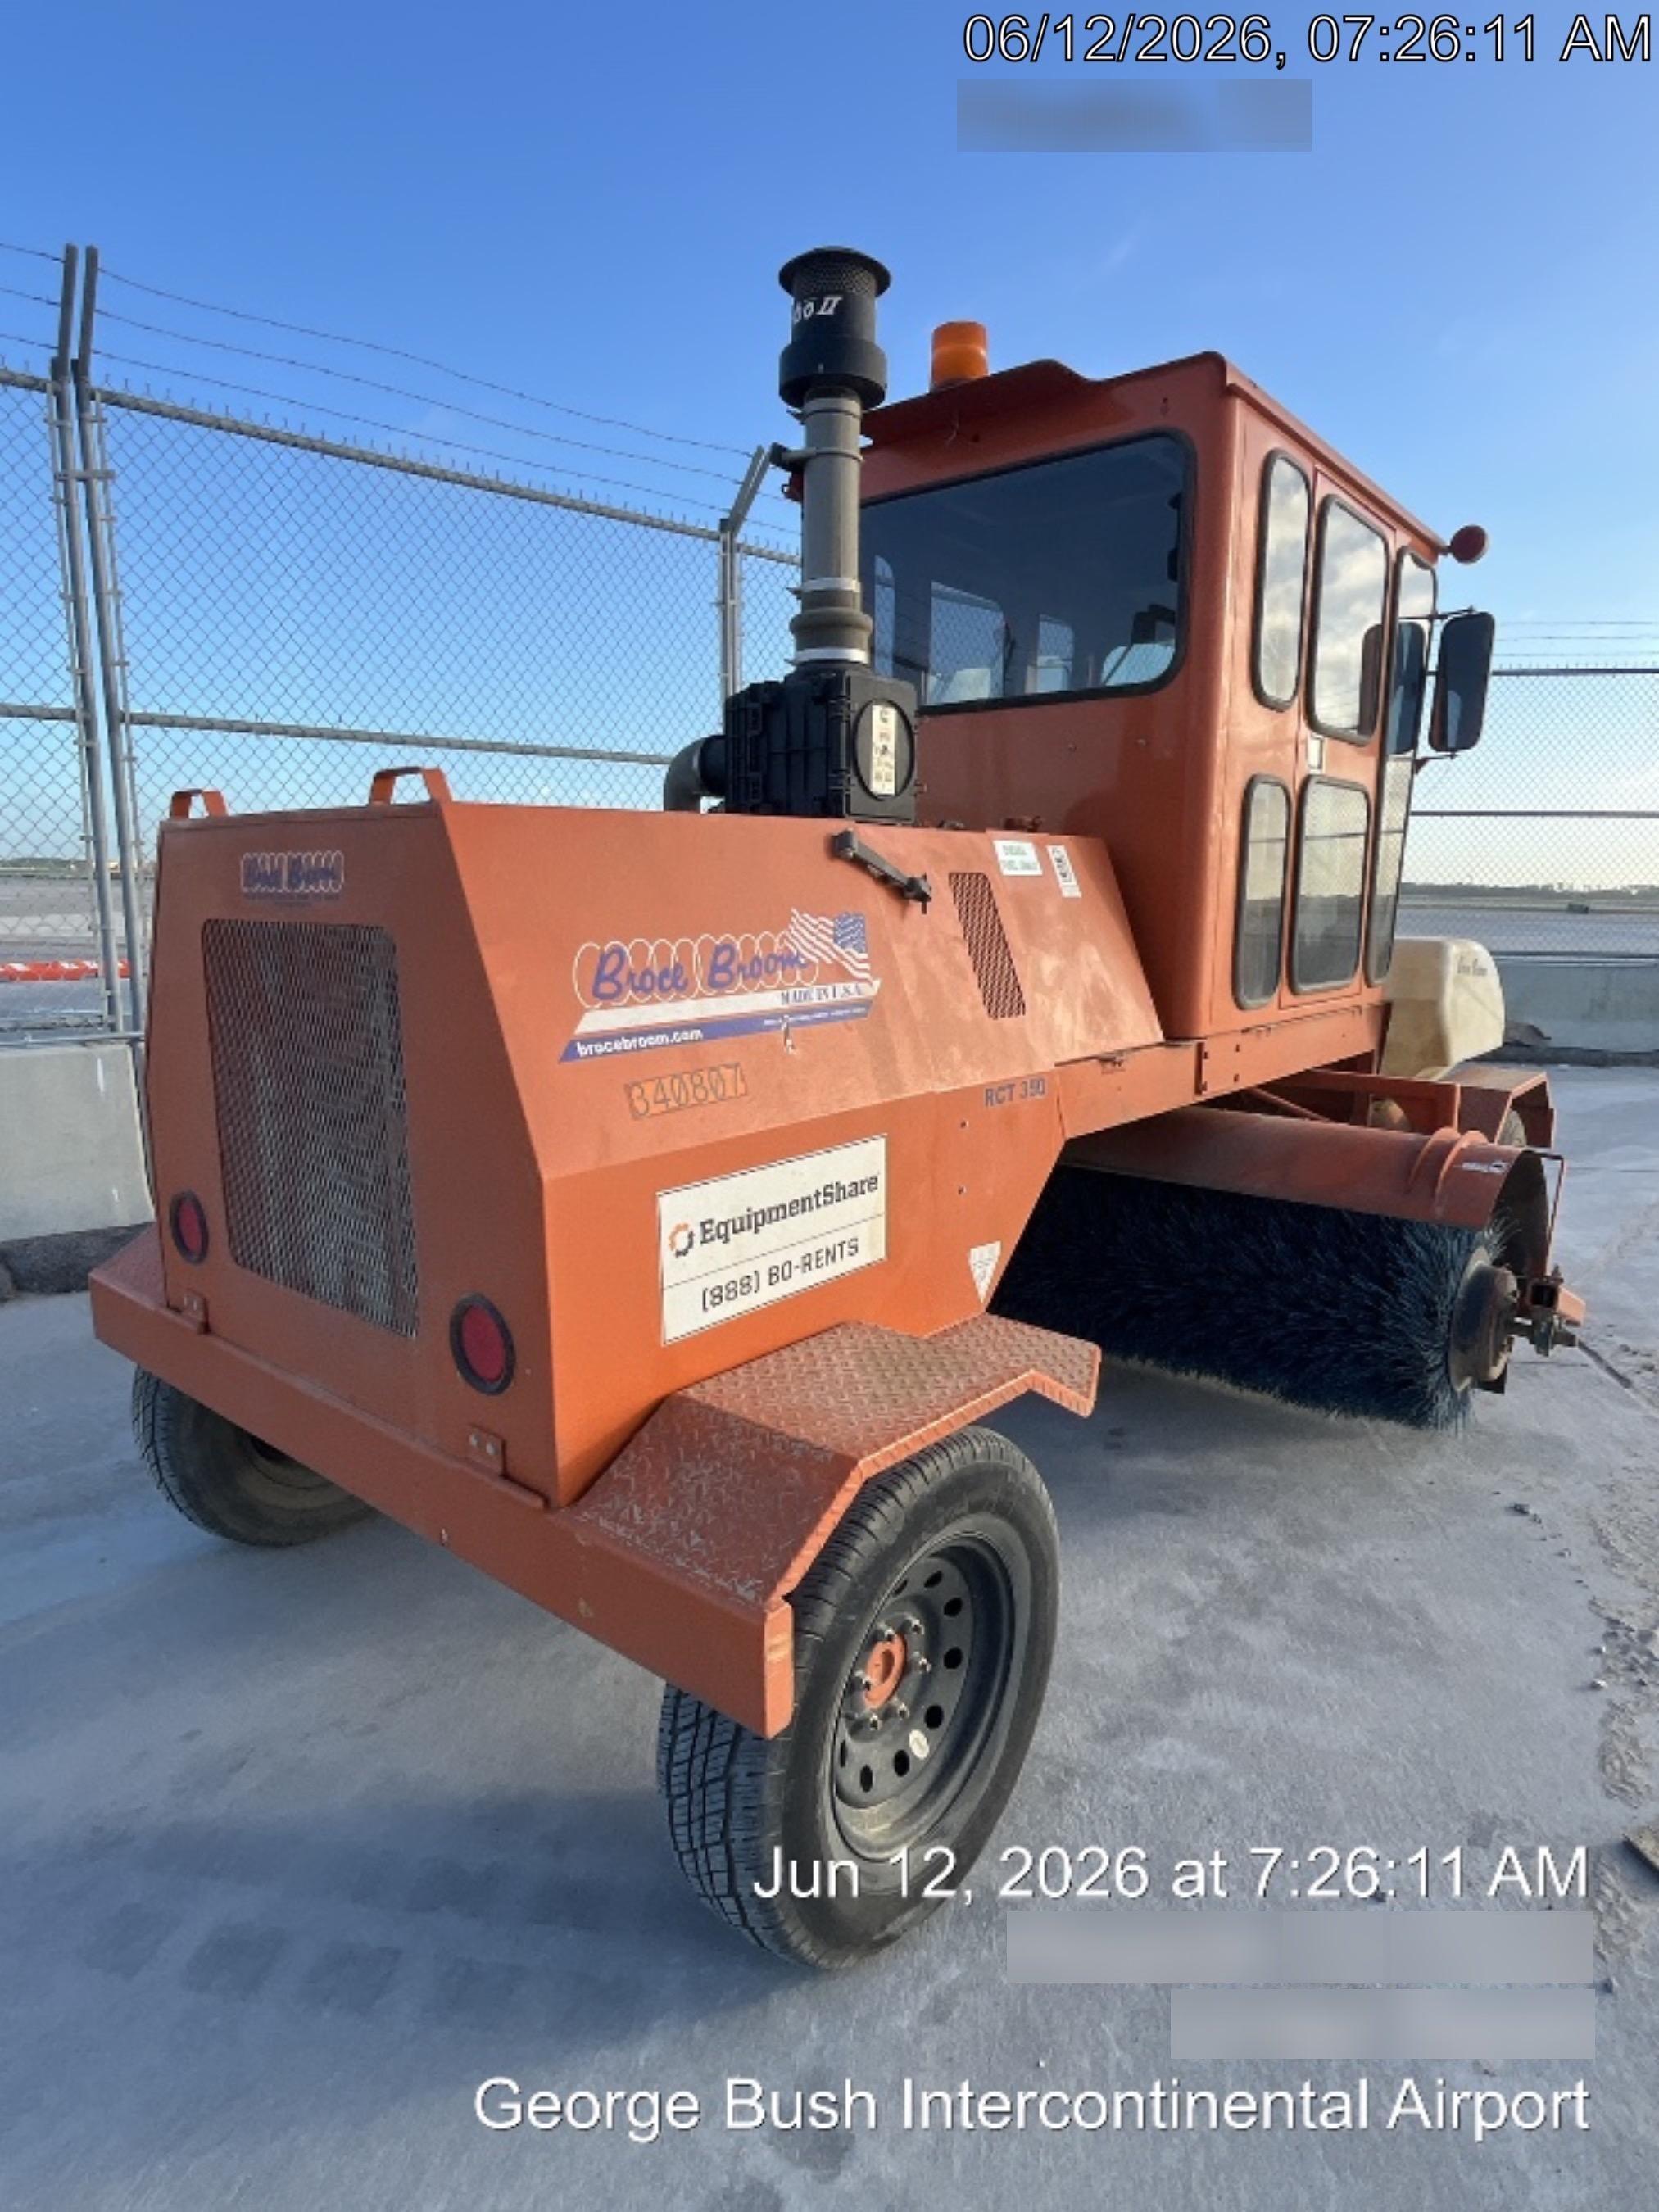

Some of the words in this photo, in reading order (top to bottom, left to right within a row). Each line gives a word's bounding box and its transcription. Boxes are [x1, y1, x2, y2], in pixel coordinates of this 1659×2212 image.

[592, 945, 689, 1001] Broce
[577, 1027, 704, 1058] brocebroom.com
[985, 1083, 1016, 1108] RCT
[700, 1175, 880, 1245] EquipmentShare
[702, 1269, 760, 1313] (888)
